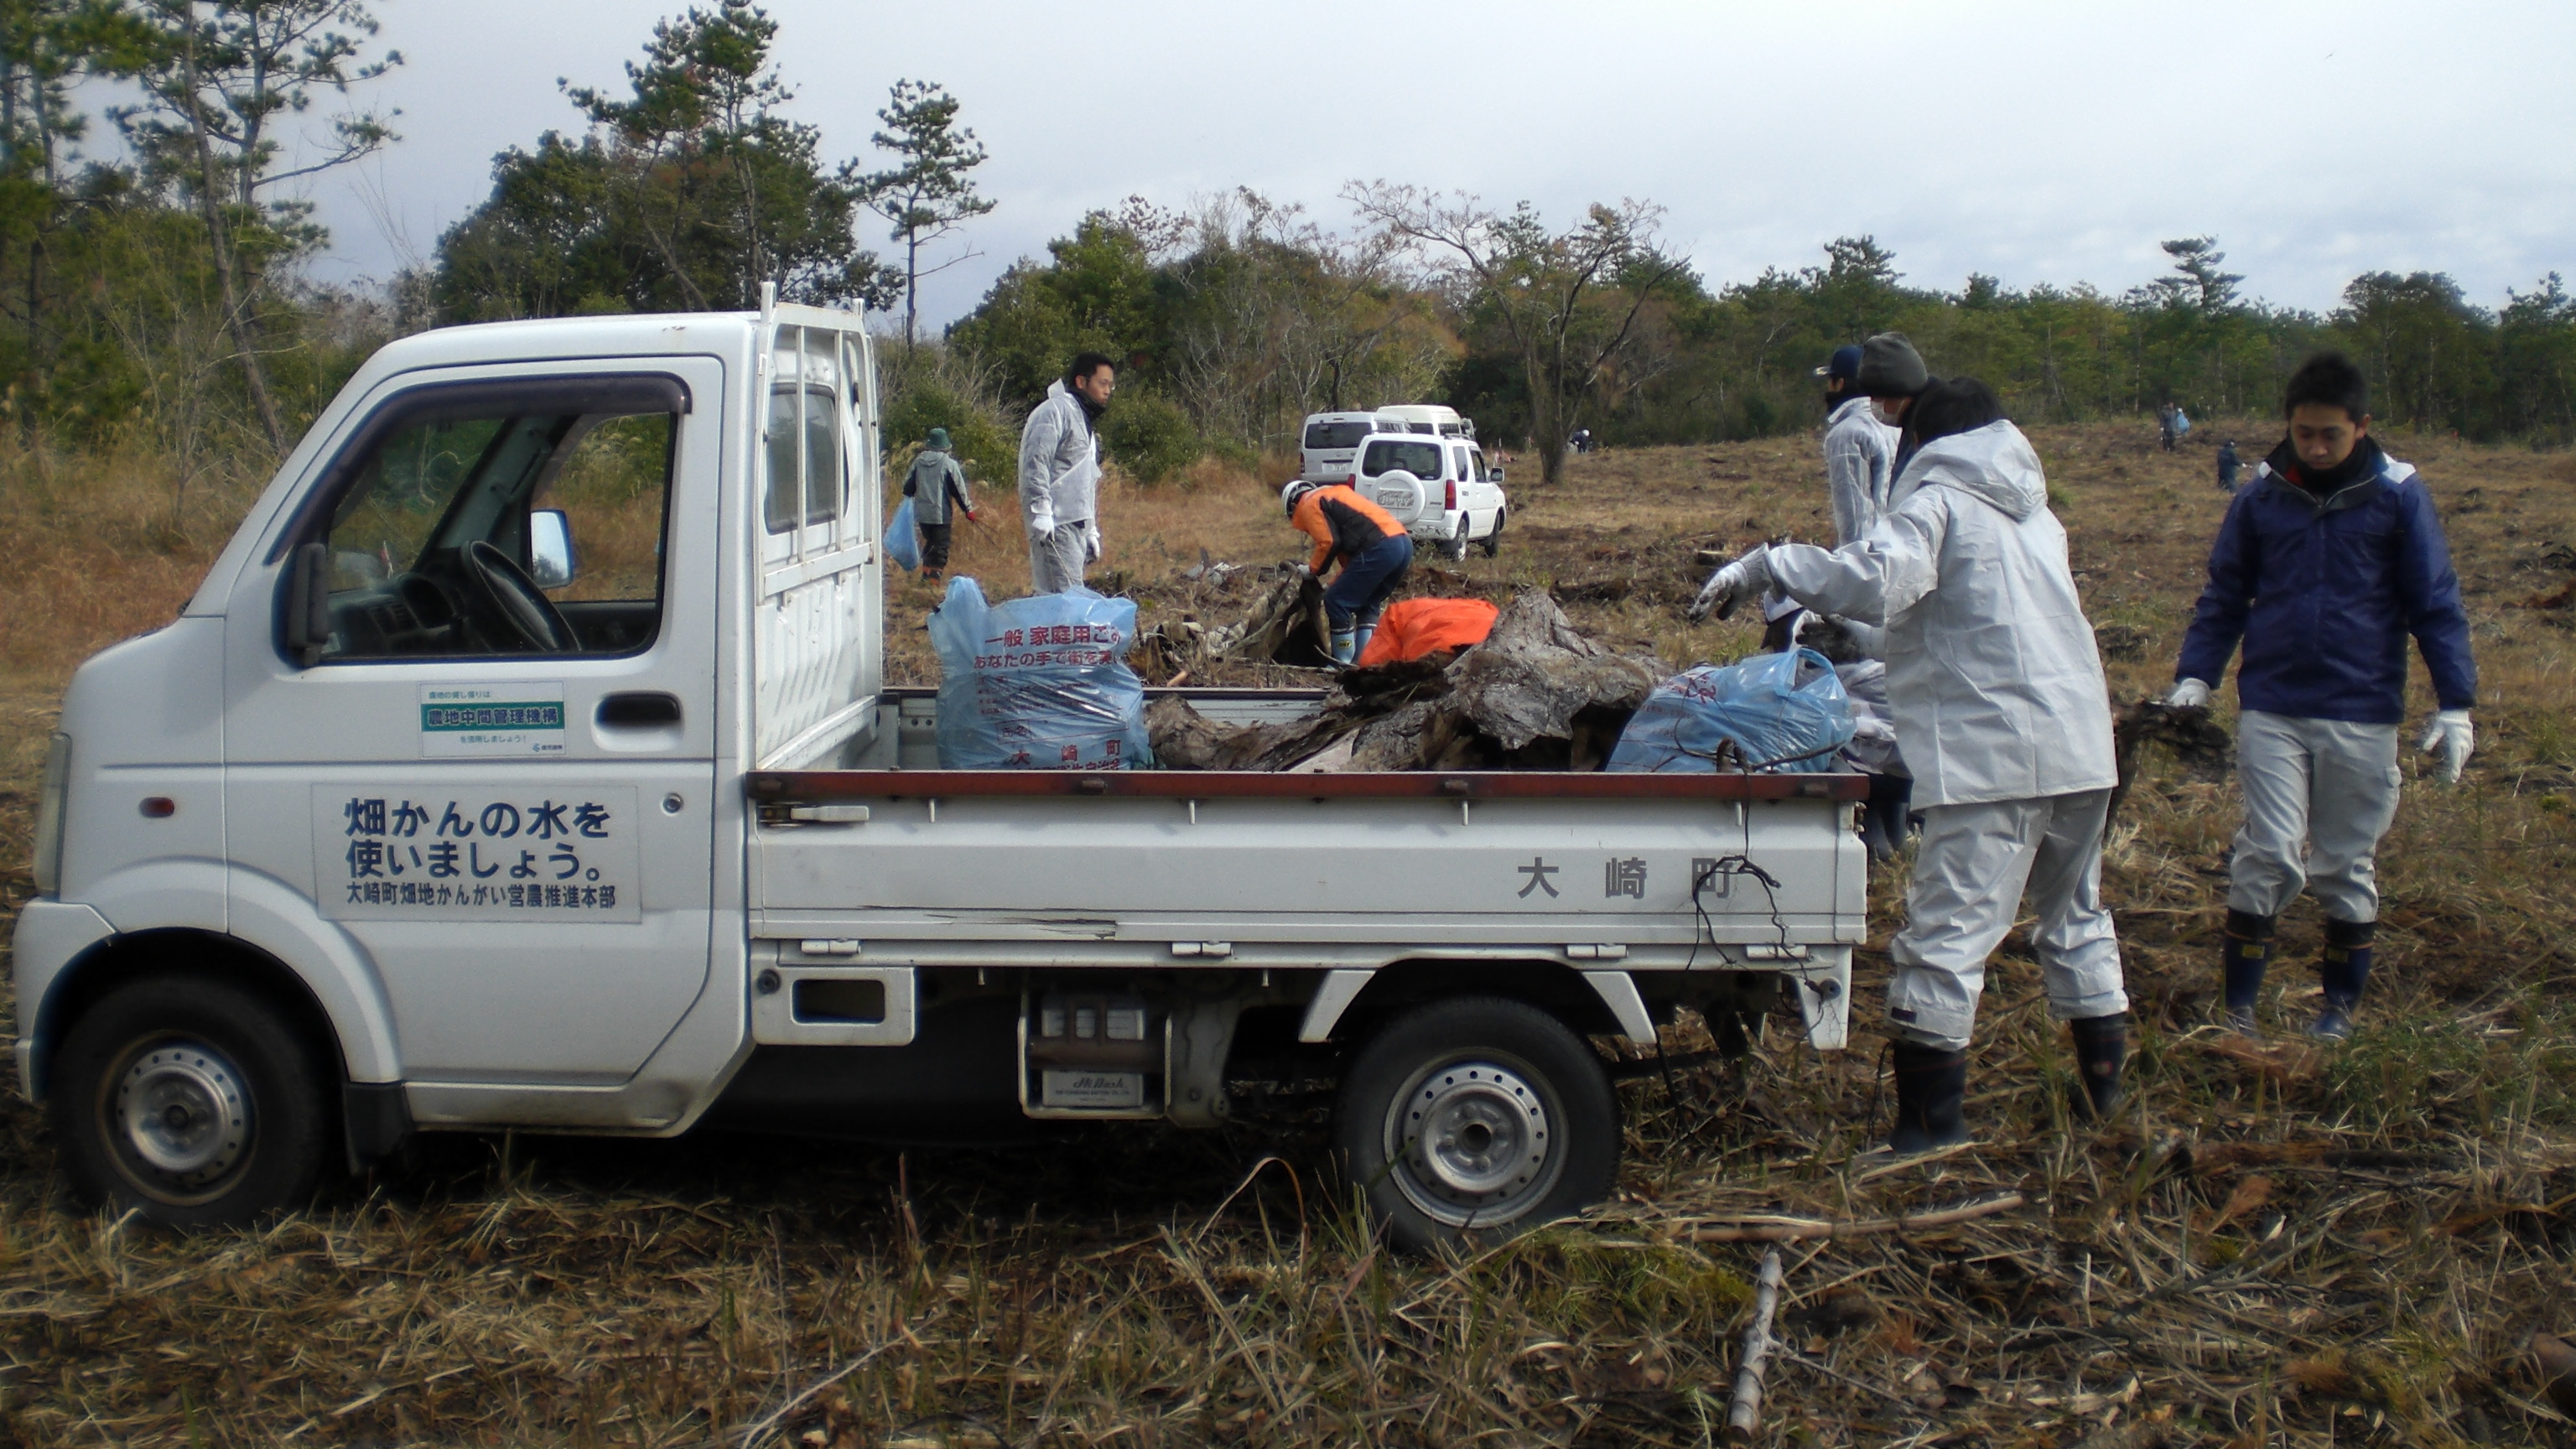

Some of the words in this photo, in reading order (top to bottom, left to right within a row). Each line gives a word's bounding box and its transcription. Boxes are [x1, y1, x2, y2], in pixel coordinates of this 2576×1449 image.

[974, 650, 1118, 669] あなたの手で街を美
[428, 708, 558, 725] 農地中間管理機構
[343, 797, 611, 839] 畑かんの水を
[345, 839, 601, 881] 使いましょう。
[345, 881, 616, 909] 大崎町畑地かんがい営農推進本部
[1517, 856, 1733, 900] 大崎町
